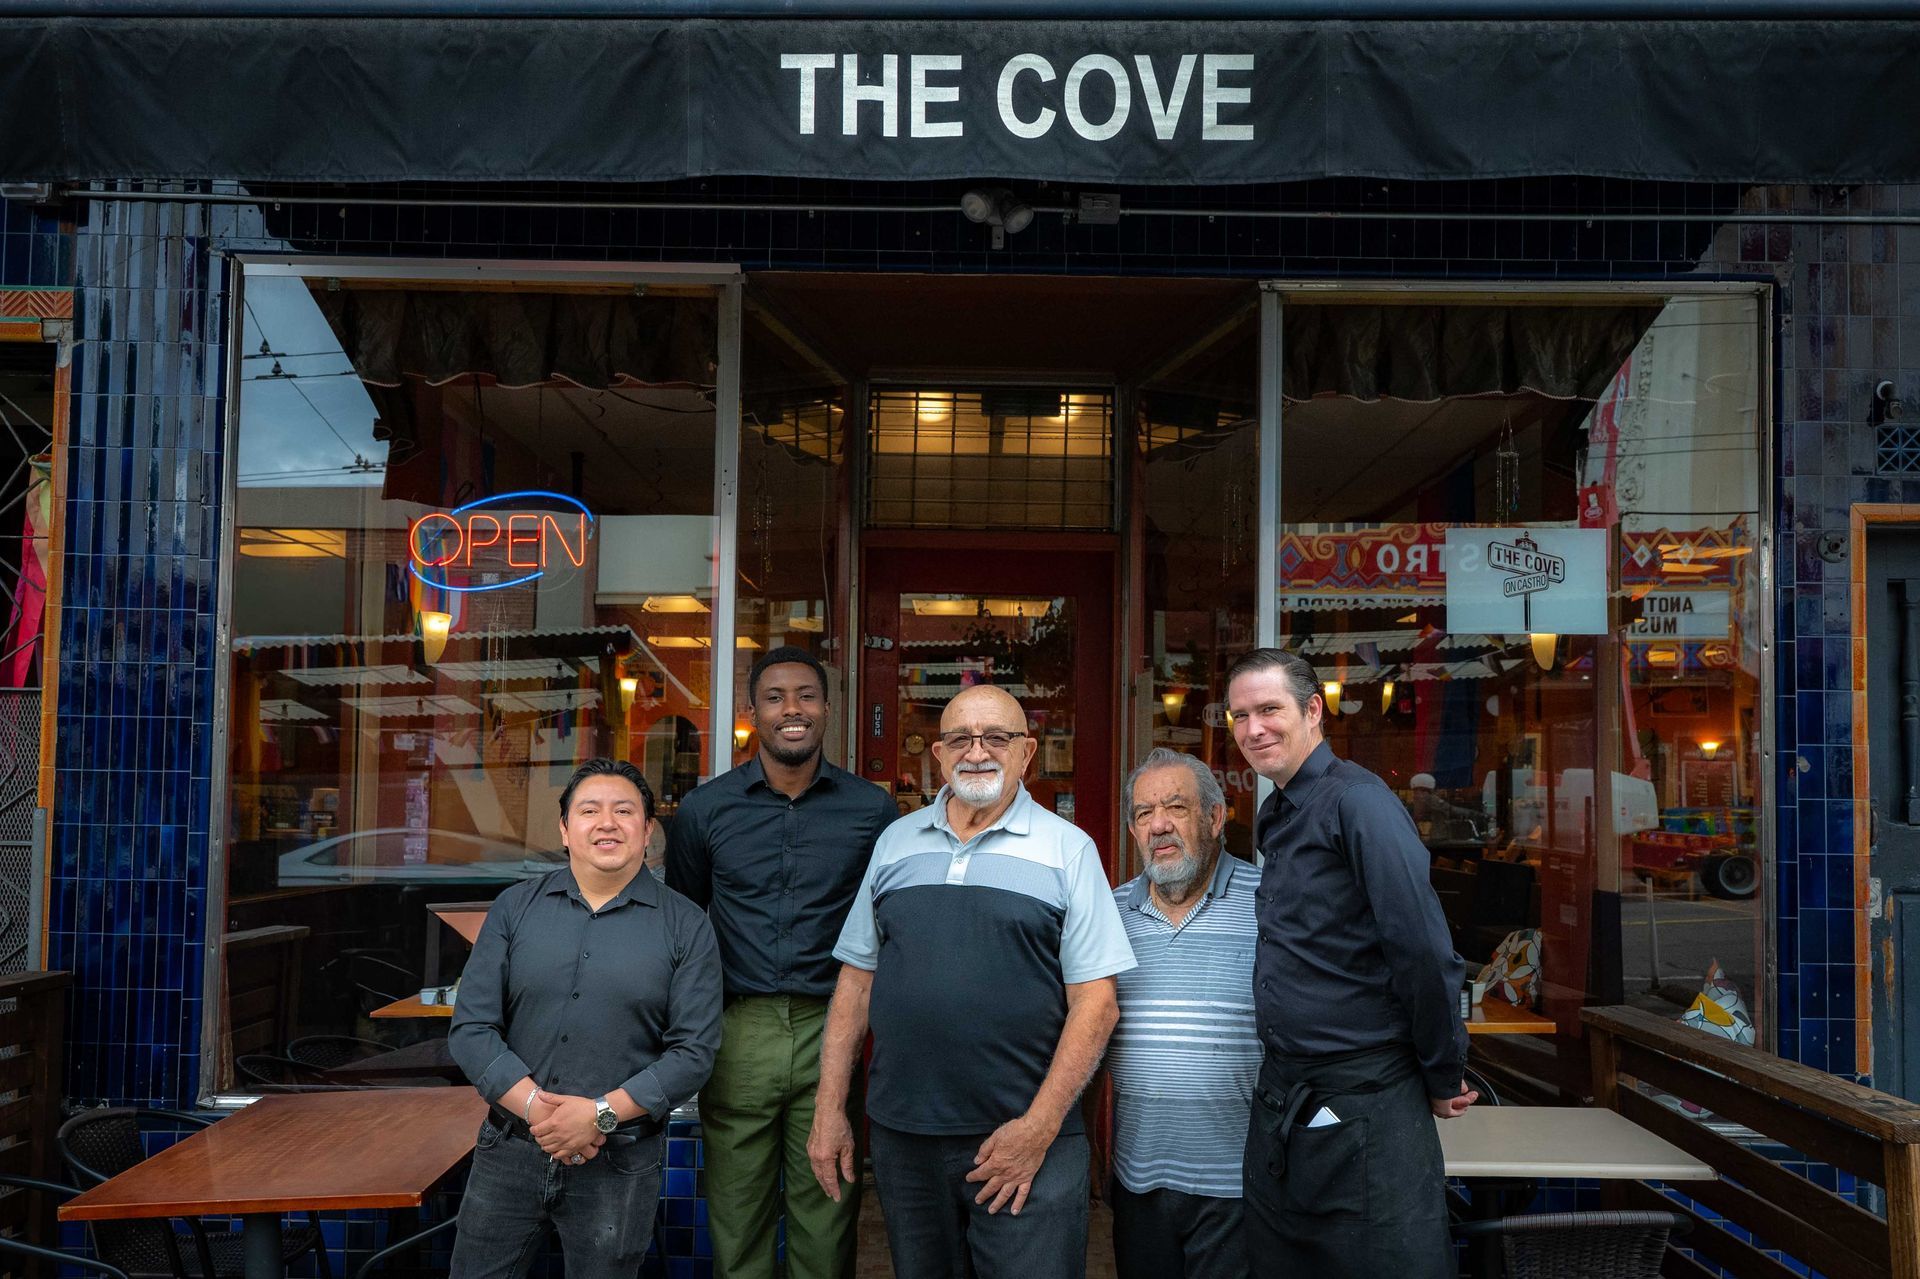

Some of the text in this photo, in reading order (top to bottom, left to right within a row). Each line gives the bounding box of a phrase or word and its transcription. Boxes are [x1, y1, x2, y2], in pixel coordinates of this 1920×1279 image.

[780, 53, 1255, 142] THE COVE
[410, 513, 586, 568] OPEN
[1494, 547, 1560, 577] THE COVE
[1505, 574, 1546, 594] ON CASTRO
